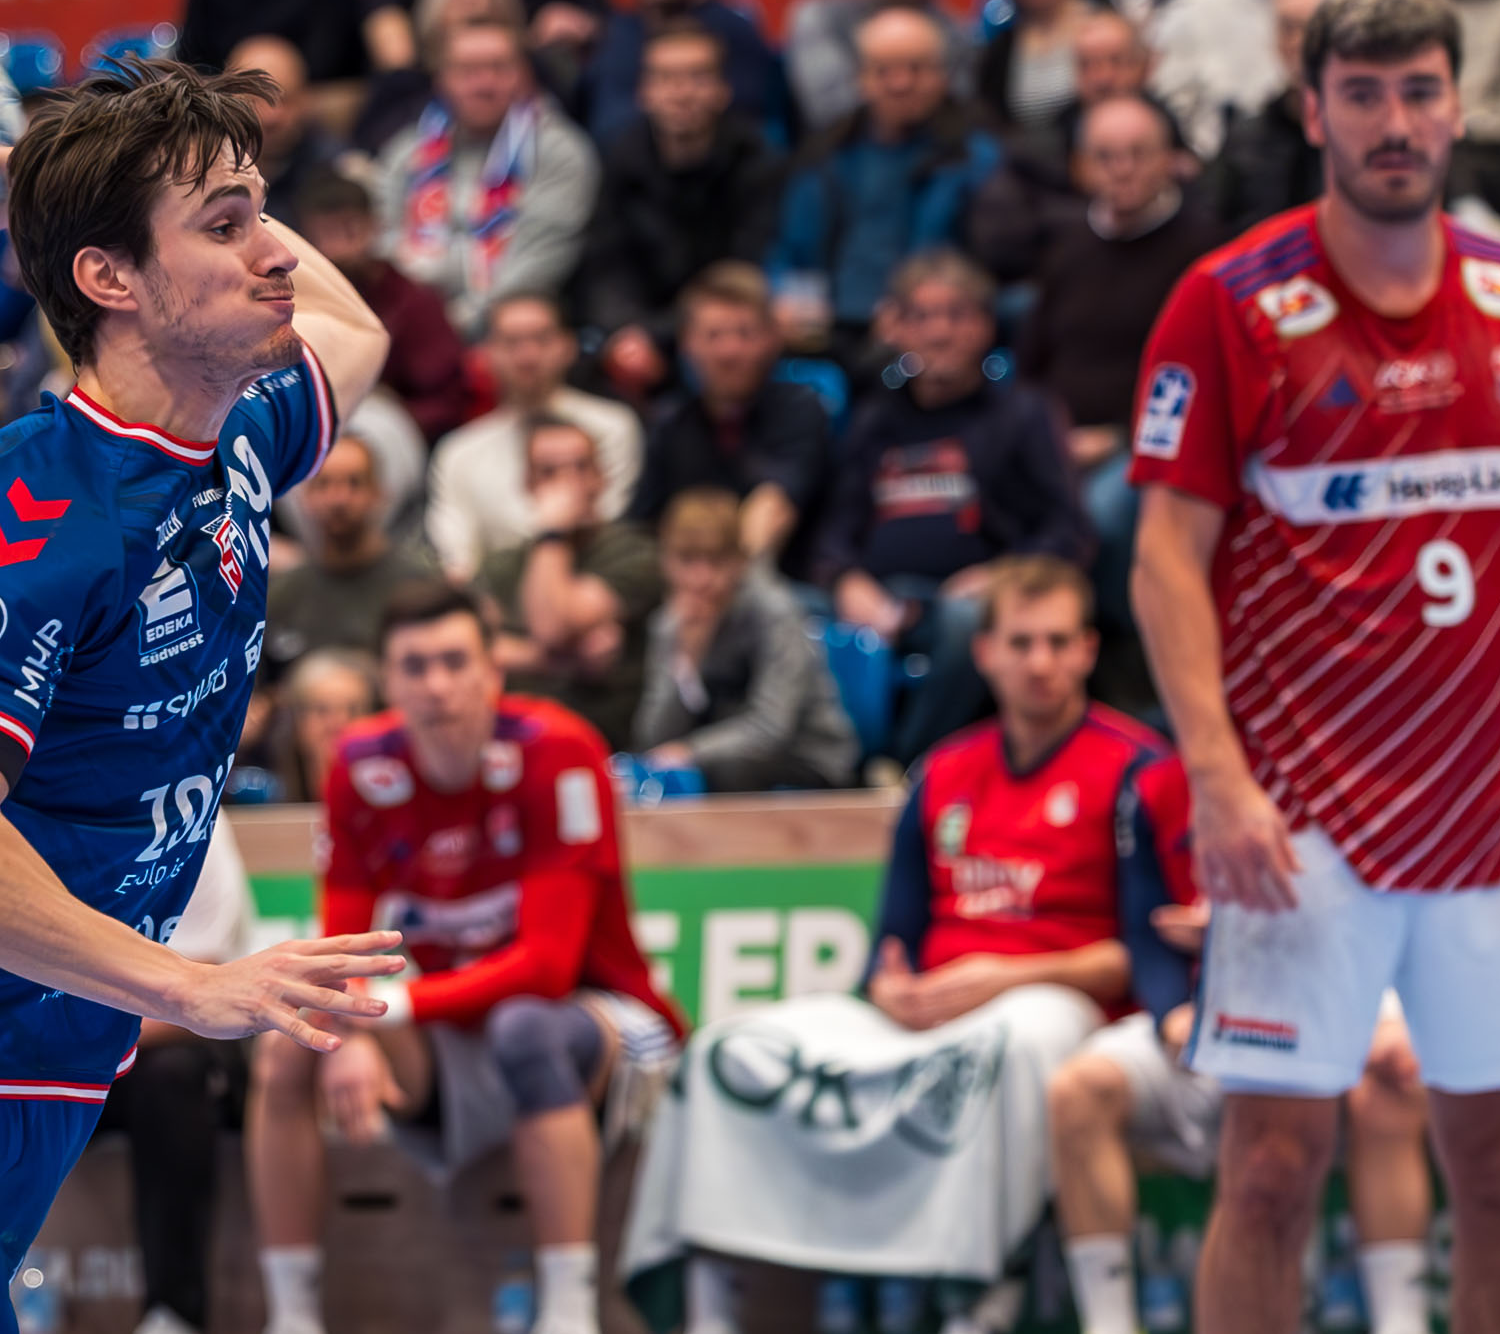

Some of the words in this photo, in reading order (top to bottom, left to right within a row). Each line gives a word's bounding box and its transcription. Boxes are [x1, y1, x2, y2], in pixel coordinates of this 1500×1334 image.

[1416, 539, 1475, 627] 9
[145, 612, 194, 643] EDEKA
[139, 632, 205, 667] Südwest
